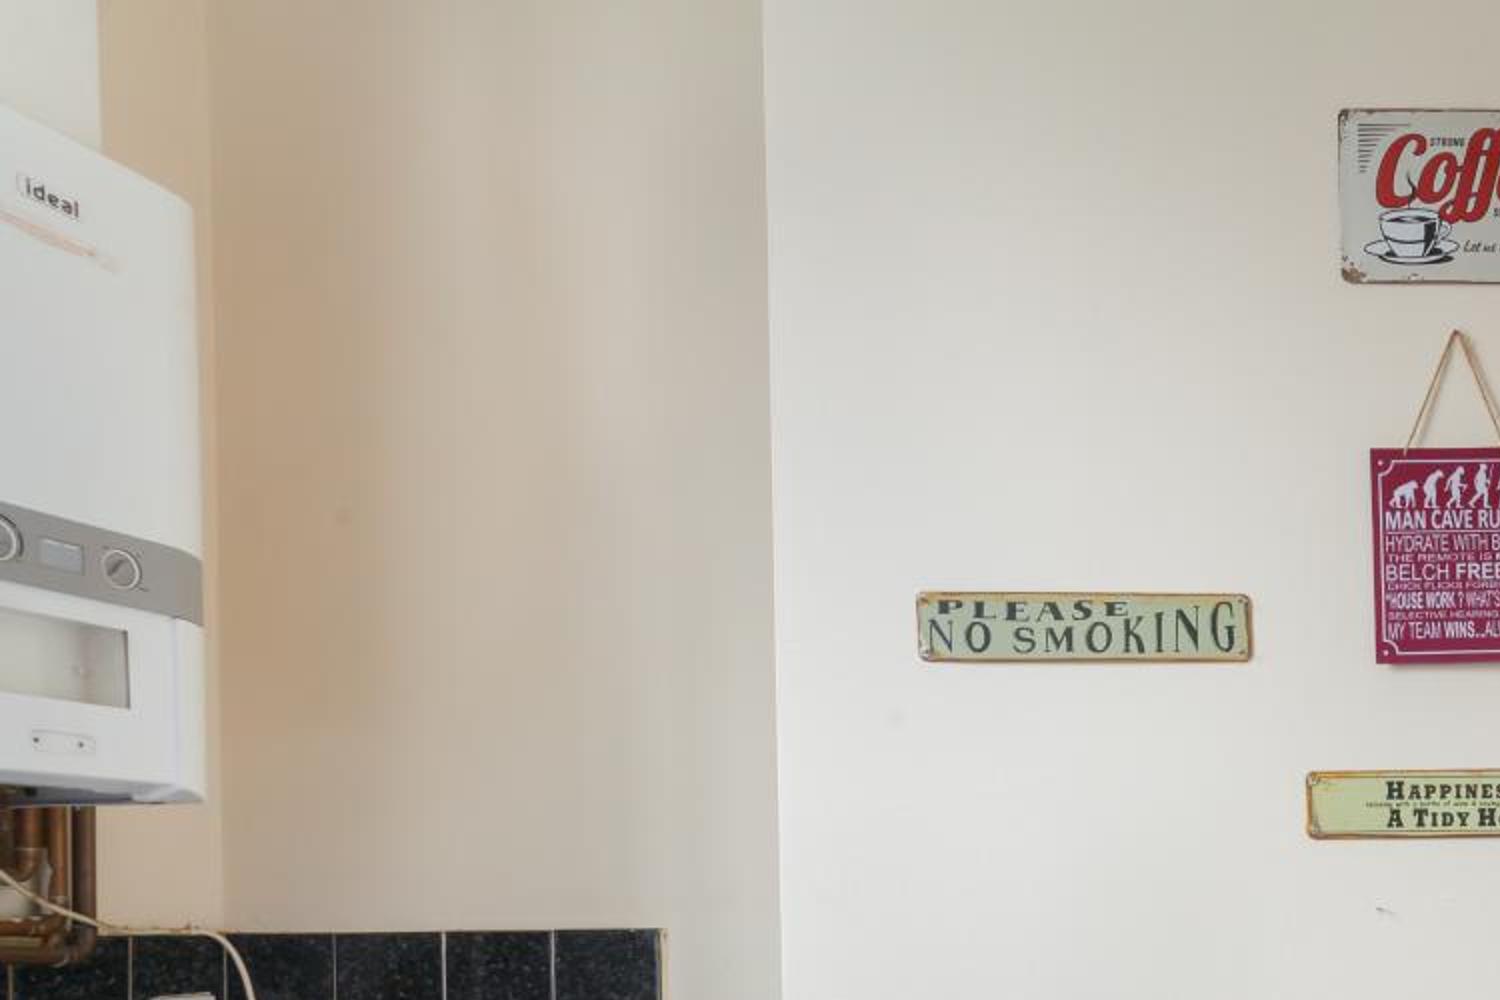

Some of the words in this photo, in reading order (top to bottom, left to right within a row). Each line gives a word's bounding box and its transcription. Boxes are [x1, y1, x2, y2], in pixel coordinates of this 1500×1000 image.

[1430, 136, 1466, 147] STRONG
[24, 176, 80, 219] ideal
[1463, 239, 1481, 253] Let
[1385, 510, 1427, 530] MAN
[1431, 509, 1474, 529] CAVE
[1385, 534, 1450, 552] HYDRATE
[1453, 533, 1490, 551] WITH
[1388, 552, 1414, 563] THE
[1418, 552, 1476, 563] REMOTE
[1479, 551, 1493, 561] IS
[1385, 562, 1450, 582] BELCH
[1425, 591, 1457, 609] WORK
[937, 600, 1130, 622] PLEASE
[928, 619, 992, 654] NO
[1012, 600, 1236, 655] SMOKING
[1388, 622, 1407, 640] MY
[1408, 621, 1441, 639] TEAM
[1386, 807, 1404, 828] A
[1413, 806, 1471, 828] TIDY
